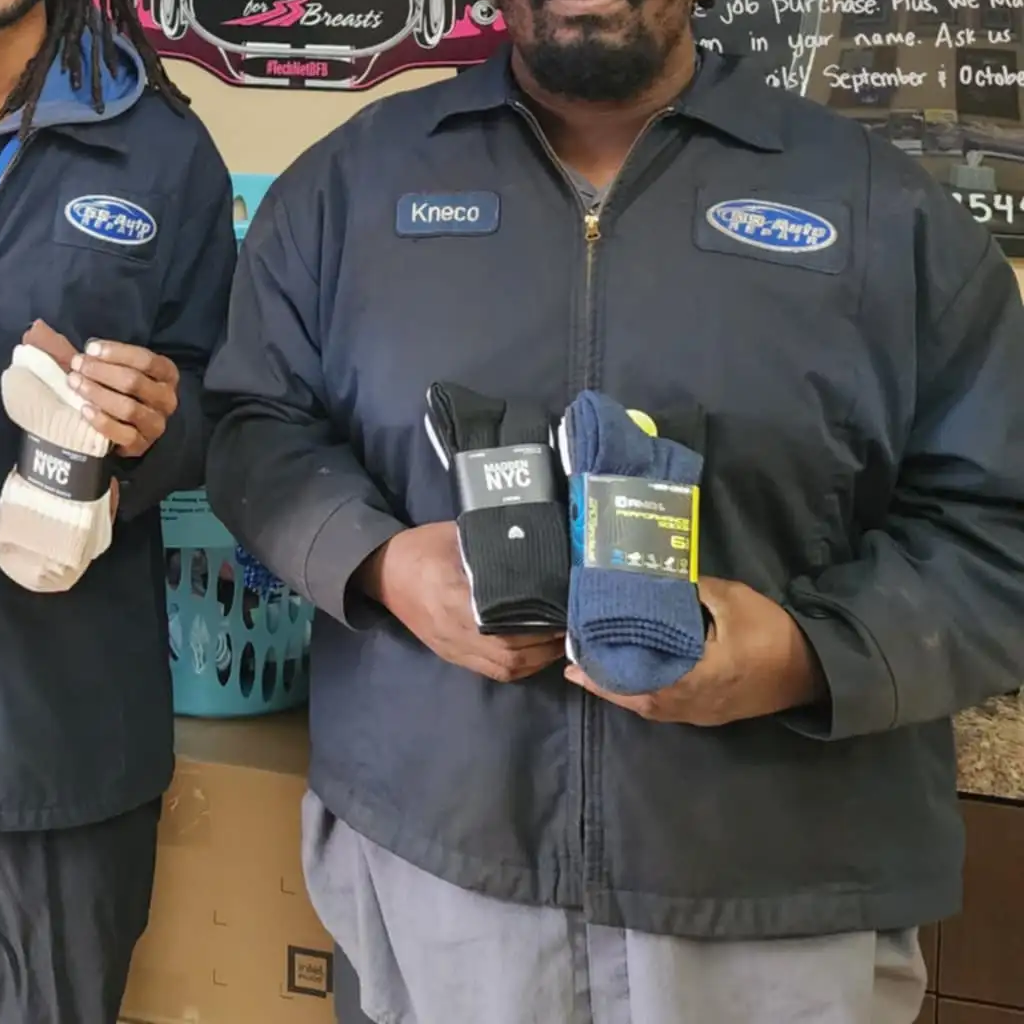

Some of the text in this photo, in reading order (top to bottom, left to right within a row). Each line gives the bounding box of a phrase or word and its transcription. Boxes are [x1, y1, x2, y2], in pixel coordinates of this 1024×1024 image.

[243, 0, 268, 17] for
[300, 2, 384, 29] Breasts
[749, 30, 768, 52] in
[788, 33, 834, 59] your
[854, 31, 922, 47] name.
[934, 22, 977, 48] Ask
[988, 28, 1012, 45] us
[823, 63, 927, 94] September
[411, 201, 480, 224] Kneco
[486, 468, 532, 491] NYC
